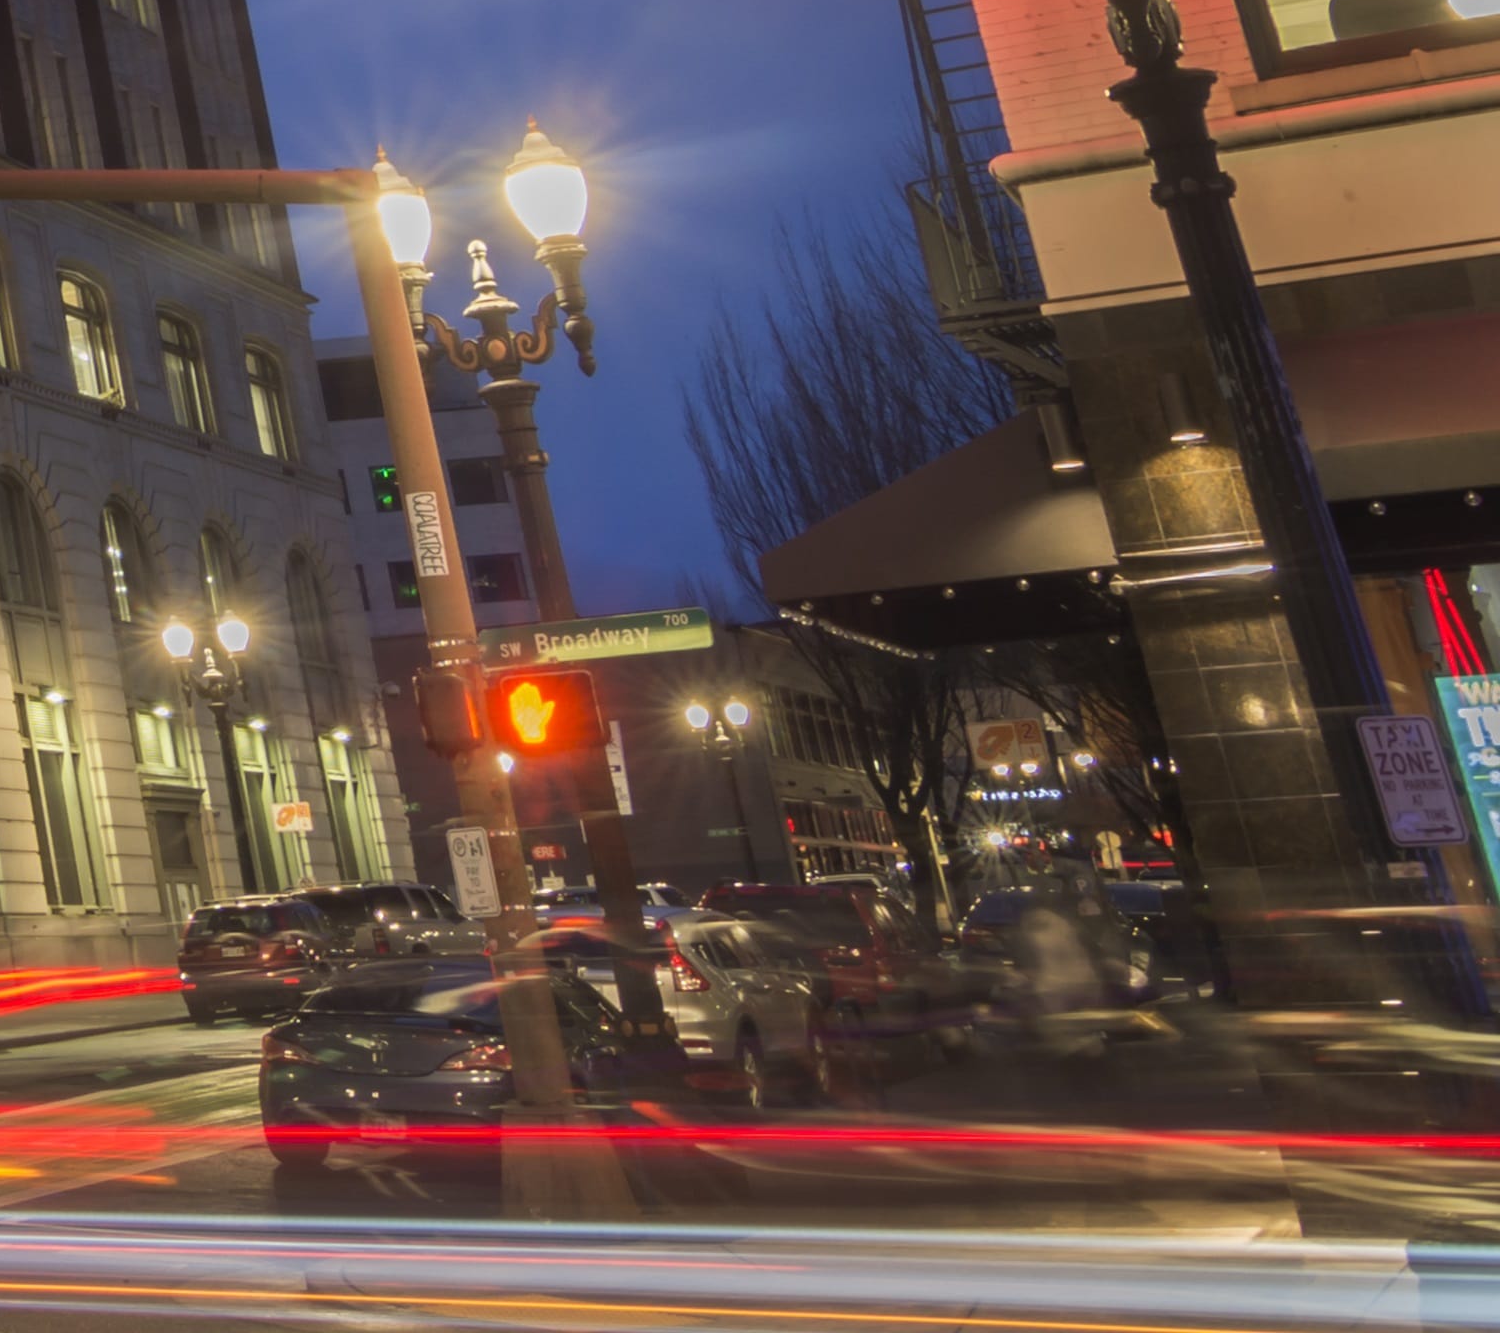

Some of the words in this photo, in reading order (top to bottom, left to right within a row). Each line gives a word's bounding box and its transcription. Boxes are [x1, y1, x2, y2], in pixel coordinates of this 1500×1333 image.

[662, 612, 689, 627] 700
[500, 641, 521, 659] SW
[534, 626, 650, 654] Broadway
[1369, 724, 1426, 749] TAXI
[1375, 751, 1440, 776] ZONE
[1382, 780, 1397, 791] NO
[1404, 778, 1445, 791] PARKING
